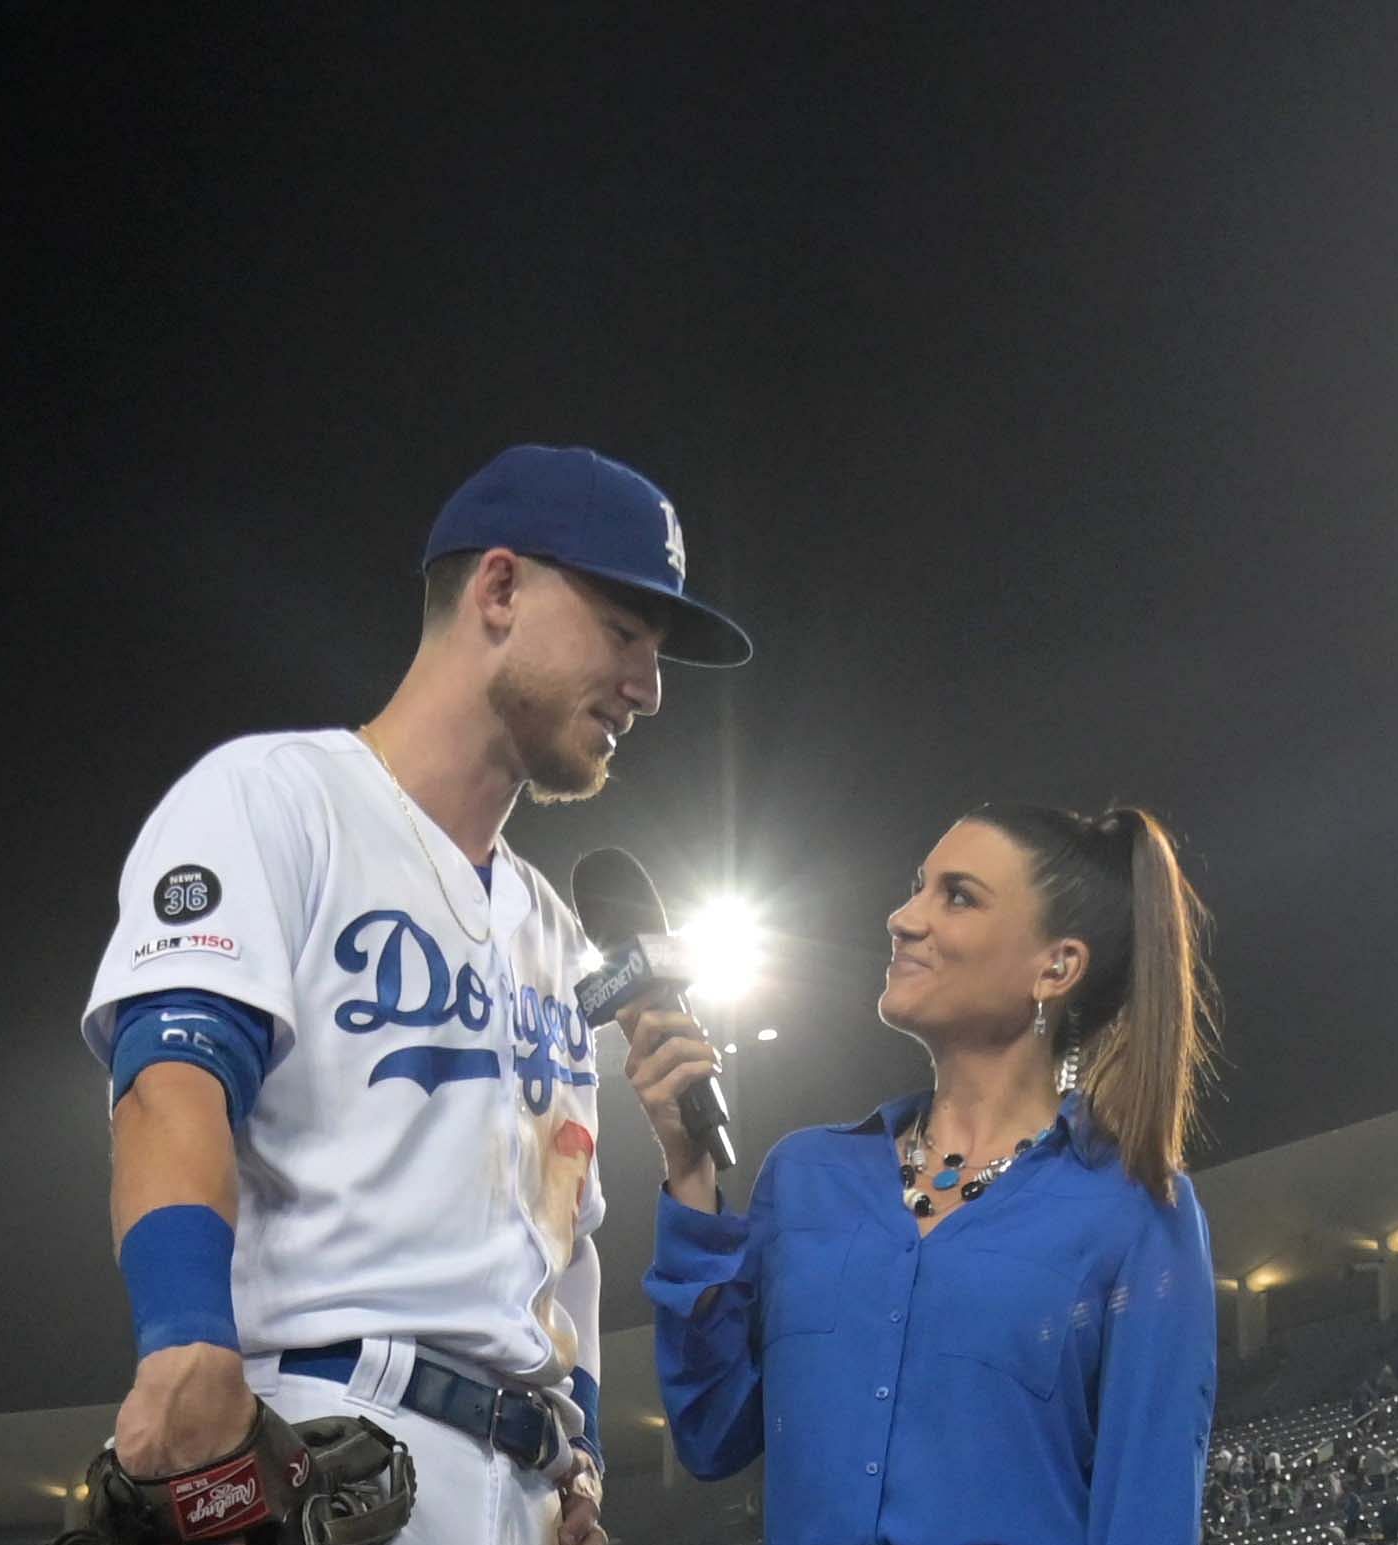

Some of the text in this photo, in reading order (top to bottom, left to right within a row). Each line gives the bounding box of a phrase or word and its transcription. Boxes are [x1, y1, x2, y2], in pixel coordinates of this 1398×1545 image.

[164, 882, 208, 916] 36
[134, 937, 170, 963] MLB
[186, 1477, 257, 1524] Rawlings
